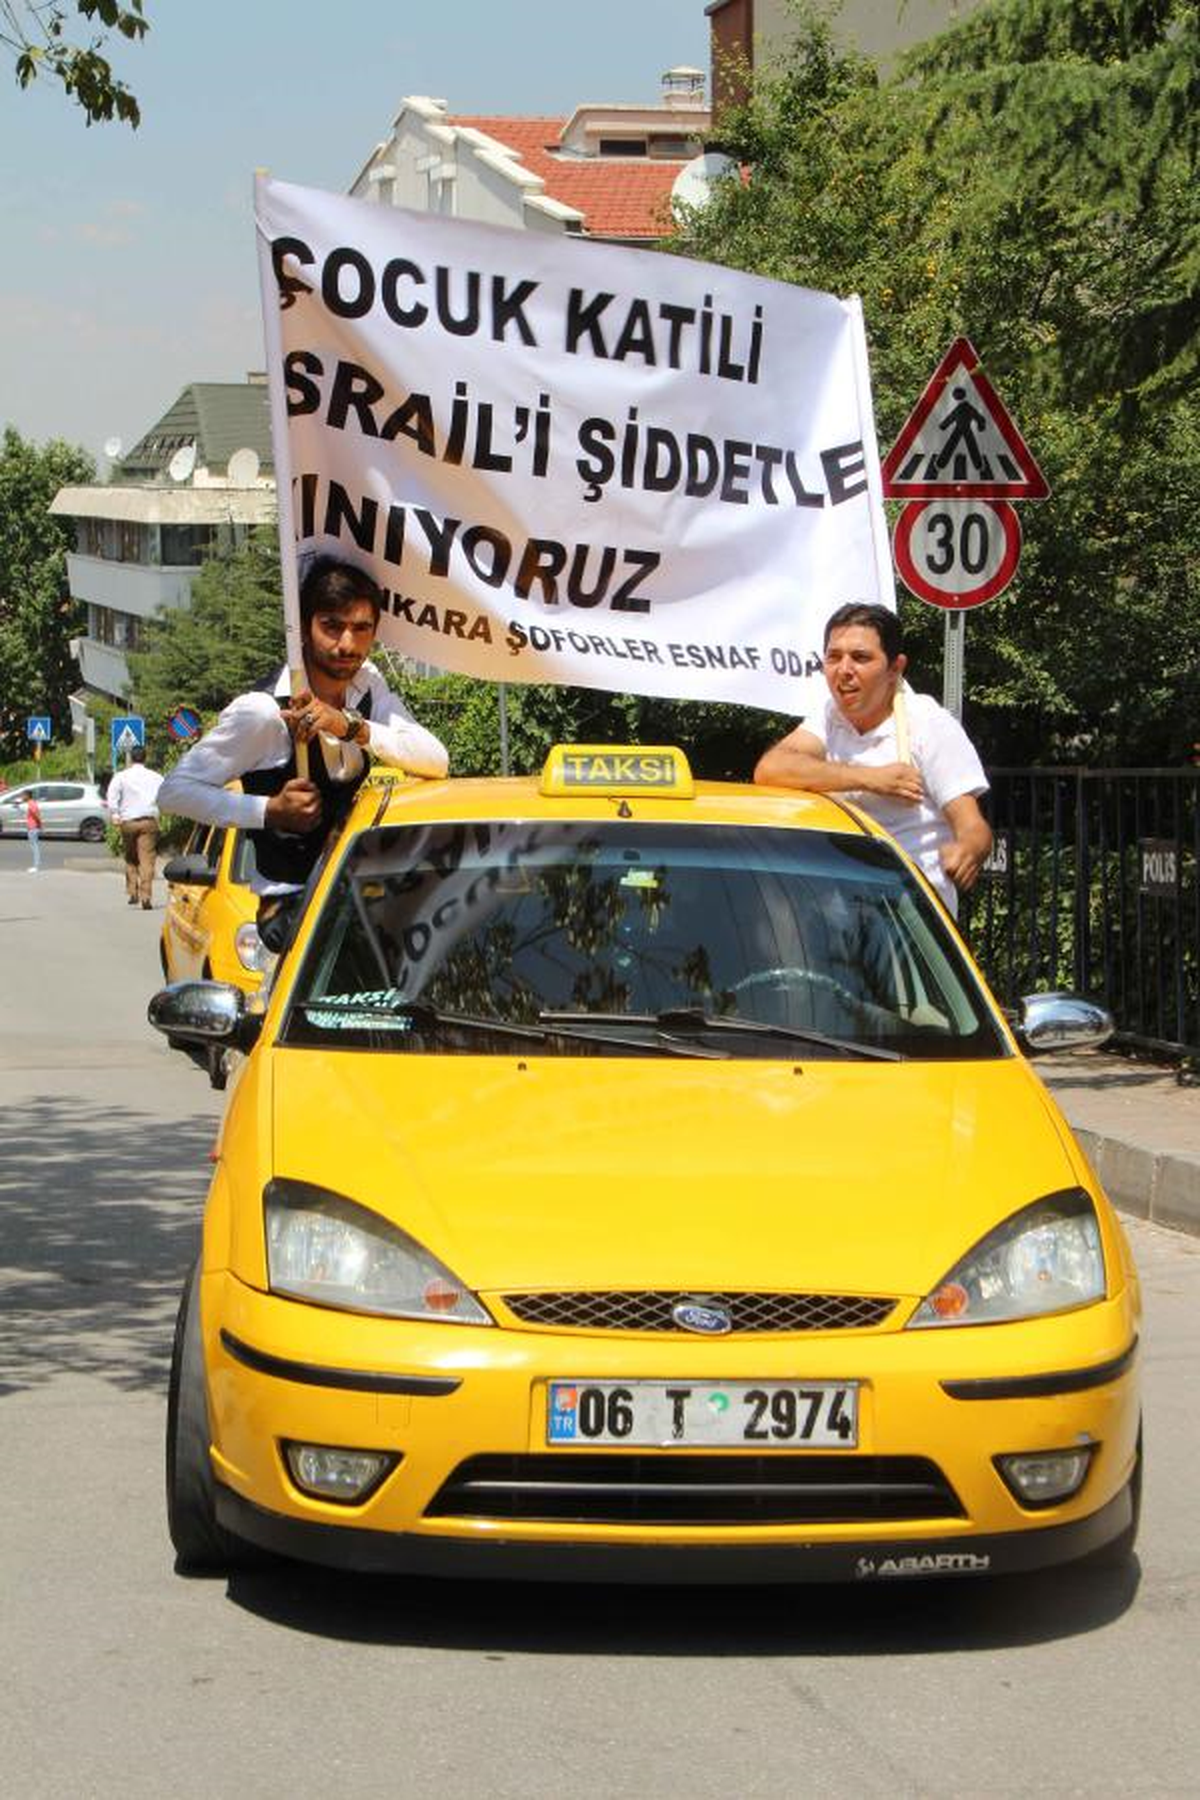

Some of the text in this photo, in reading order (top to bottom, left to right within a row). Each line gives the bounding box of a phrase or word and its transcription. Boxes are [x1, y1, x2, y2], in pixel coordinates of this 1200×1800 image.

[271, 237, 764, 384] ÇOCUK KATİLİ
[576, 407, 869, 508] ŞİDDETLE
[291, 474, 661, 613] INIYORUZ
[926, 513, 989, 574] 30
[506, 621, 664, 664] ŞOFÖRLER
[668, 643, 760, 671] ESNAF
[554, 1415, 574, 1432] TR
[579, 1388, 853, 1440] 06 T 2974
[878, 1554, 991, 1576] ABARTH
